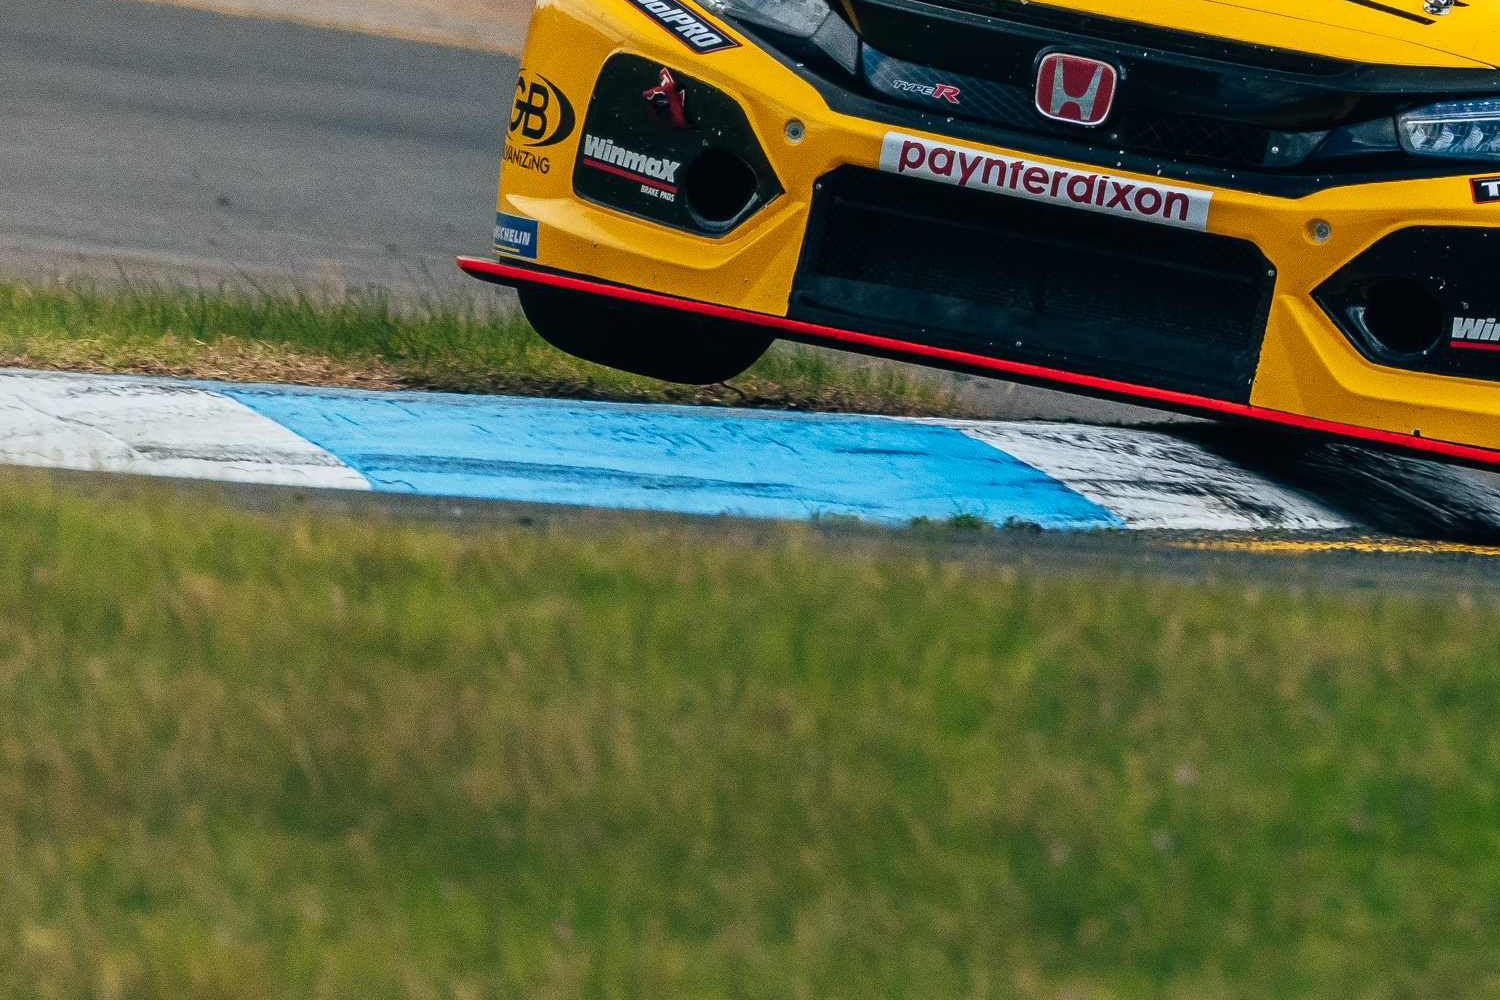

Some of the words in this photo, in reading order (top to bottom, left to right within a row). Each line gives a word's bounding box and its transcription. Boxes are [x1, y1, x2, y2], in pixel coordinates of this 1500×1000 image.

[893, 79, 935, 96] TYPE
[932, 83, 960, 104] R
[640, 184, 659, 198] BRAKE
[660, 189, 675, 202] PADS
[900, 138, 1190, 223] paynterdixon
